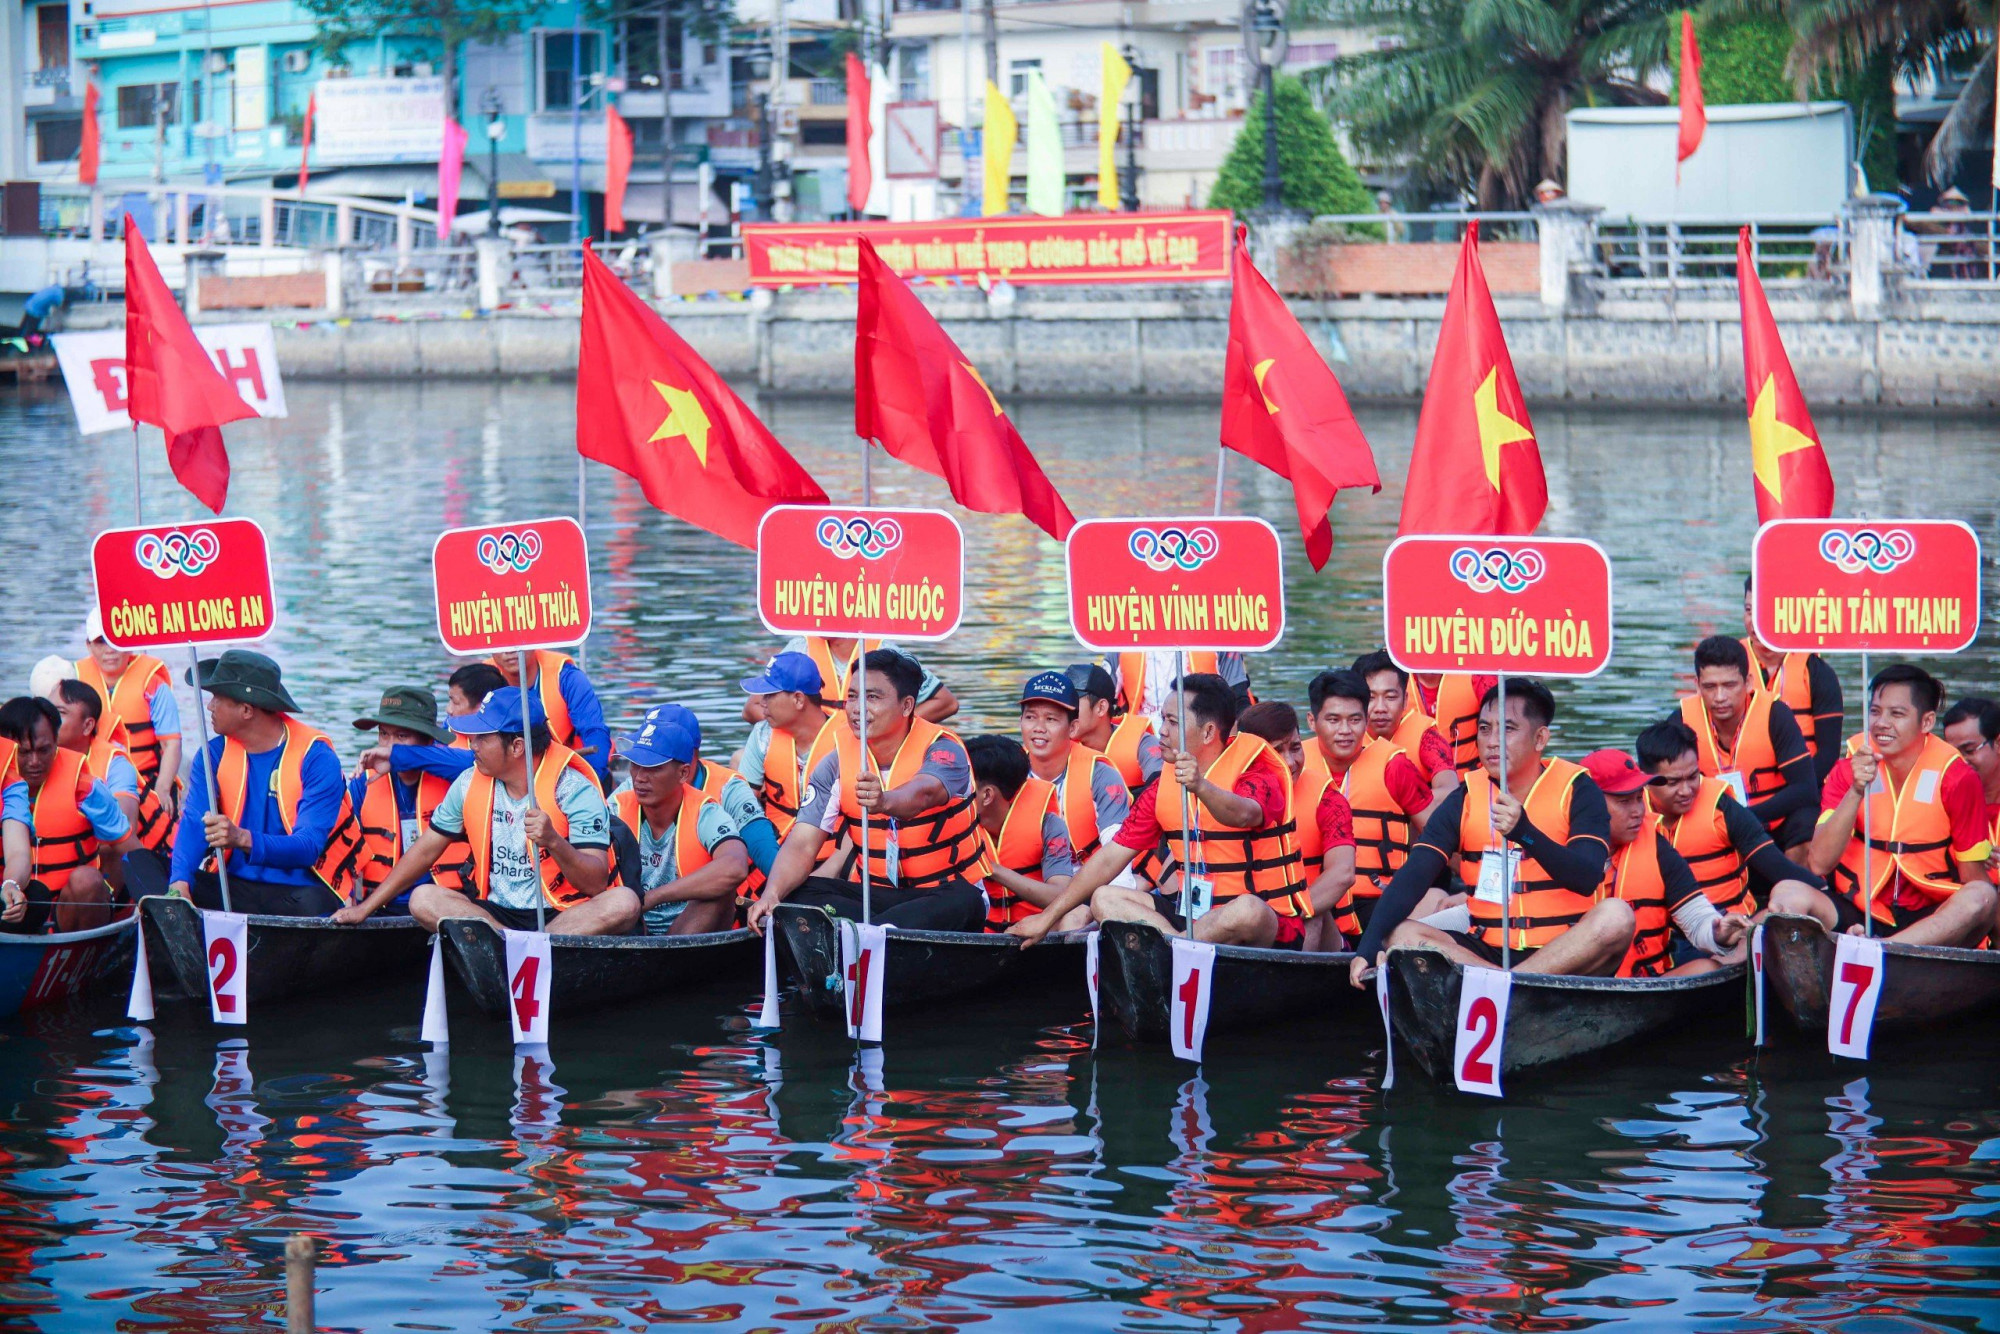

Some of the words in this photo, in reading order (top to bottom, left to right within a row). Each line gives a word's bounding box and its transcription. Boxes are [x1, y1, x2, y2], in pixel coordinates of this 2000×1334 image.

[110, 599, 159, 638] CÔNG
[162, 602, 186, 634] AN
[187, 597, 237, 632] LONG
[240, 595, 265, 627] AN
[450, 590, 504, 645] HUYỆN
[504, 580, 537, 632] THỦ
[538, 580, 581, 628] THỪA
[775, 572, 838, 627] HUYỆN
[842, 567, 881, 618] CẦN
[886, 576, 945, 631] GIUỘC
[1087, 586, 1156, 642] HUYỆN
[1160, 583, 1209, 631] VĨNH
[1213, 587, 1269, 632] HƯNG
[1774, 587, 1842, 645] HUYỆN
[1847, 588, 1887, 634] TÂN
[1892, 597, 1961, 646] THẠNH
[1404, 607, 1485, 666] HUYỆN
[1490, 607, 1539, 657] ĐỨC
[1544, 608, 1594, 658] HÒA
[208, 937, 238, 1013] 2
[511, 956, 540, 1032] 4
[848, 948, 871, 1027] 1
[1179, 967, 1200, 1050] 1
[1840, 962, 1874, 1045] 7
[1461, 996, 1498, 1085] 2
